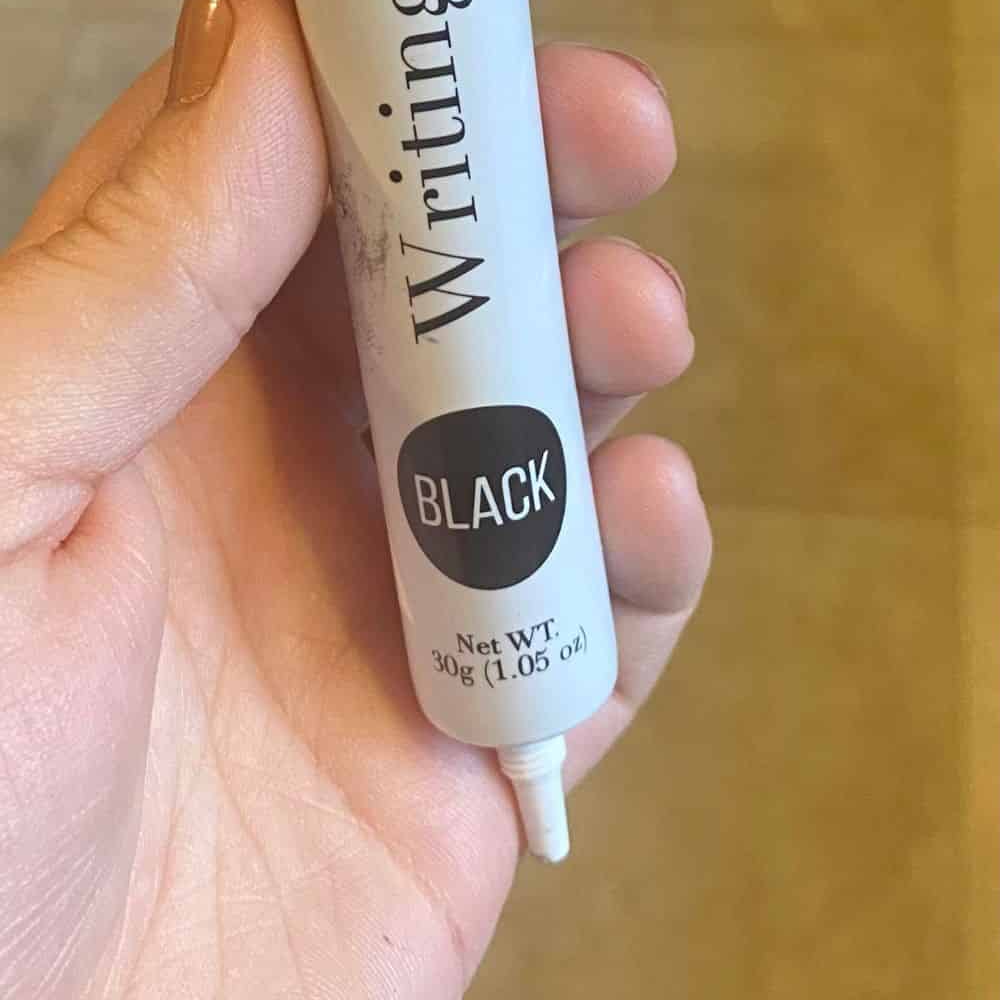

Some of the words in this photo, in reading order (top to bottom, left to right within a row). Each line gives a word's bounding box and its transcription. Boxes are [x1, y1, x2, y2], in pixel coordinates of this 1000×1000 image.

[414, 449, 556, 529] BLACK
[432, 649, 474, 686] 30g
[483, 649, 550, 689] (1.05
[560, 625, 588, 661] oz)
[456, 632, 502, 655] Net
[506, 618, 559, 651] WT.
